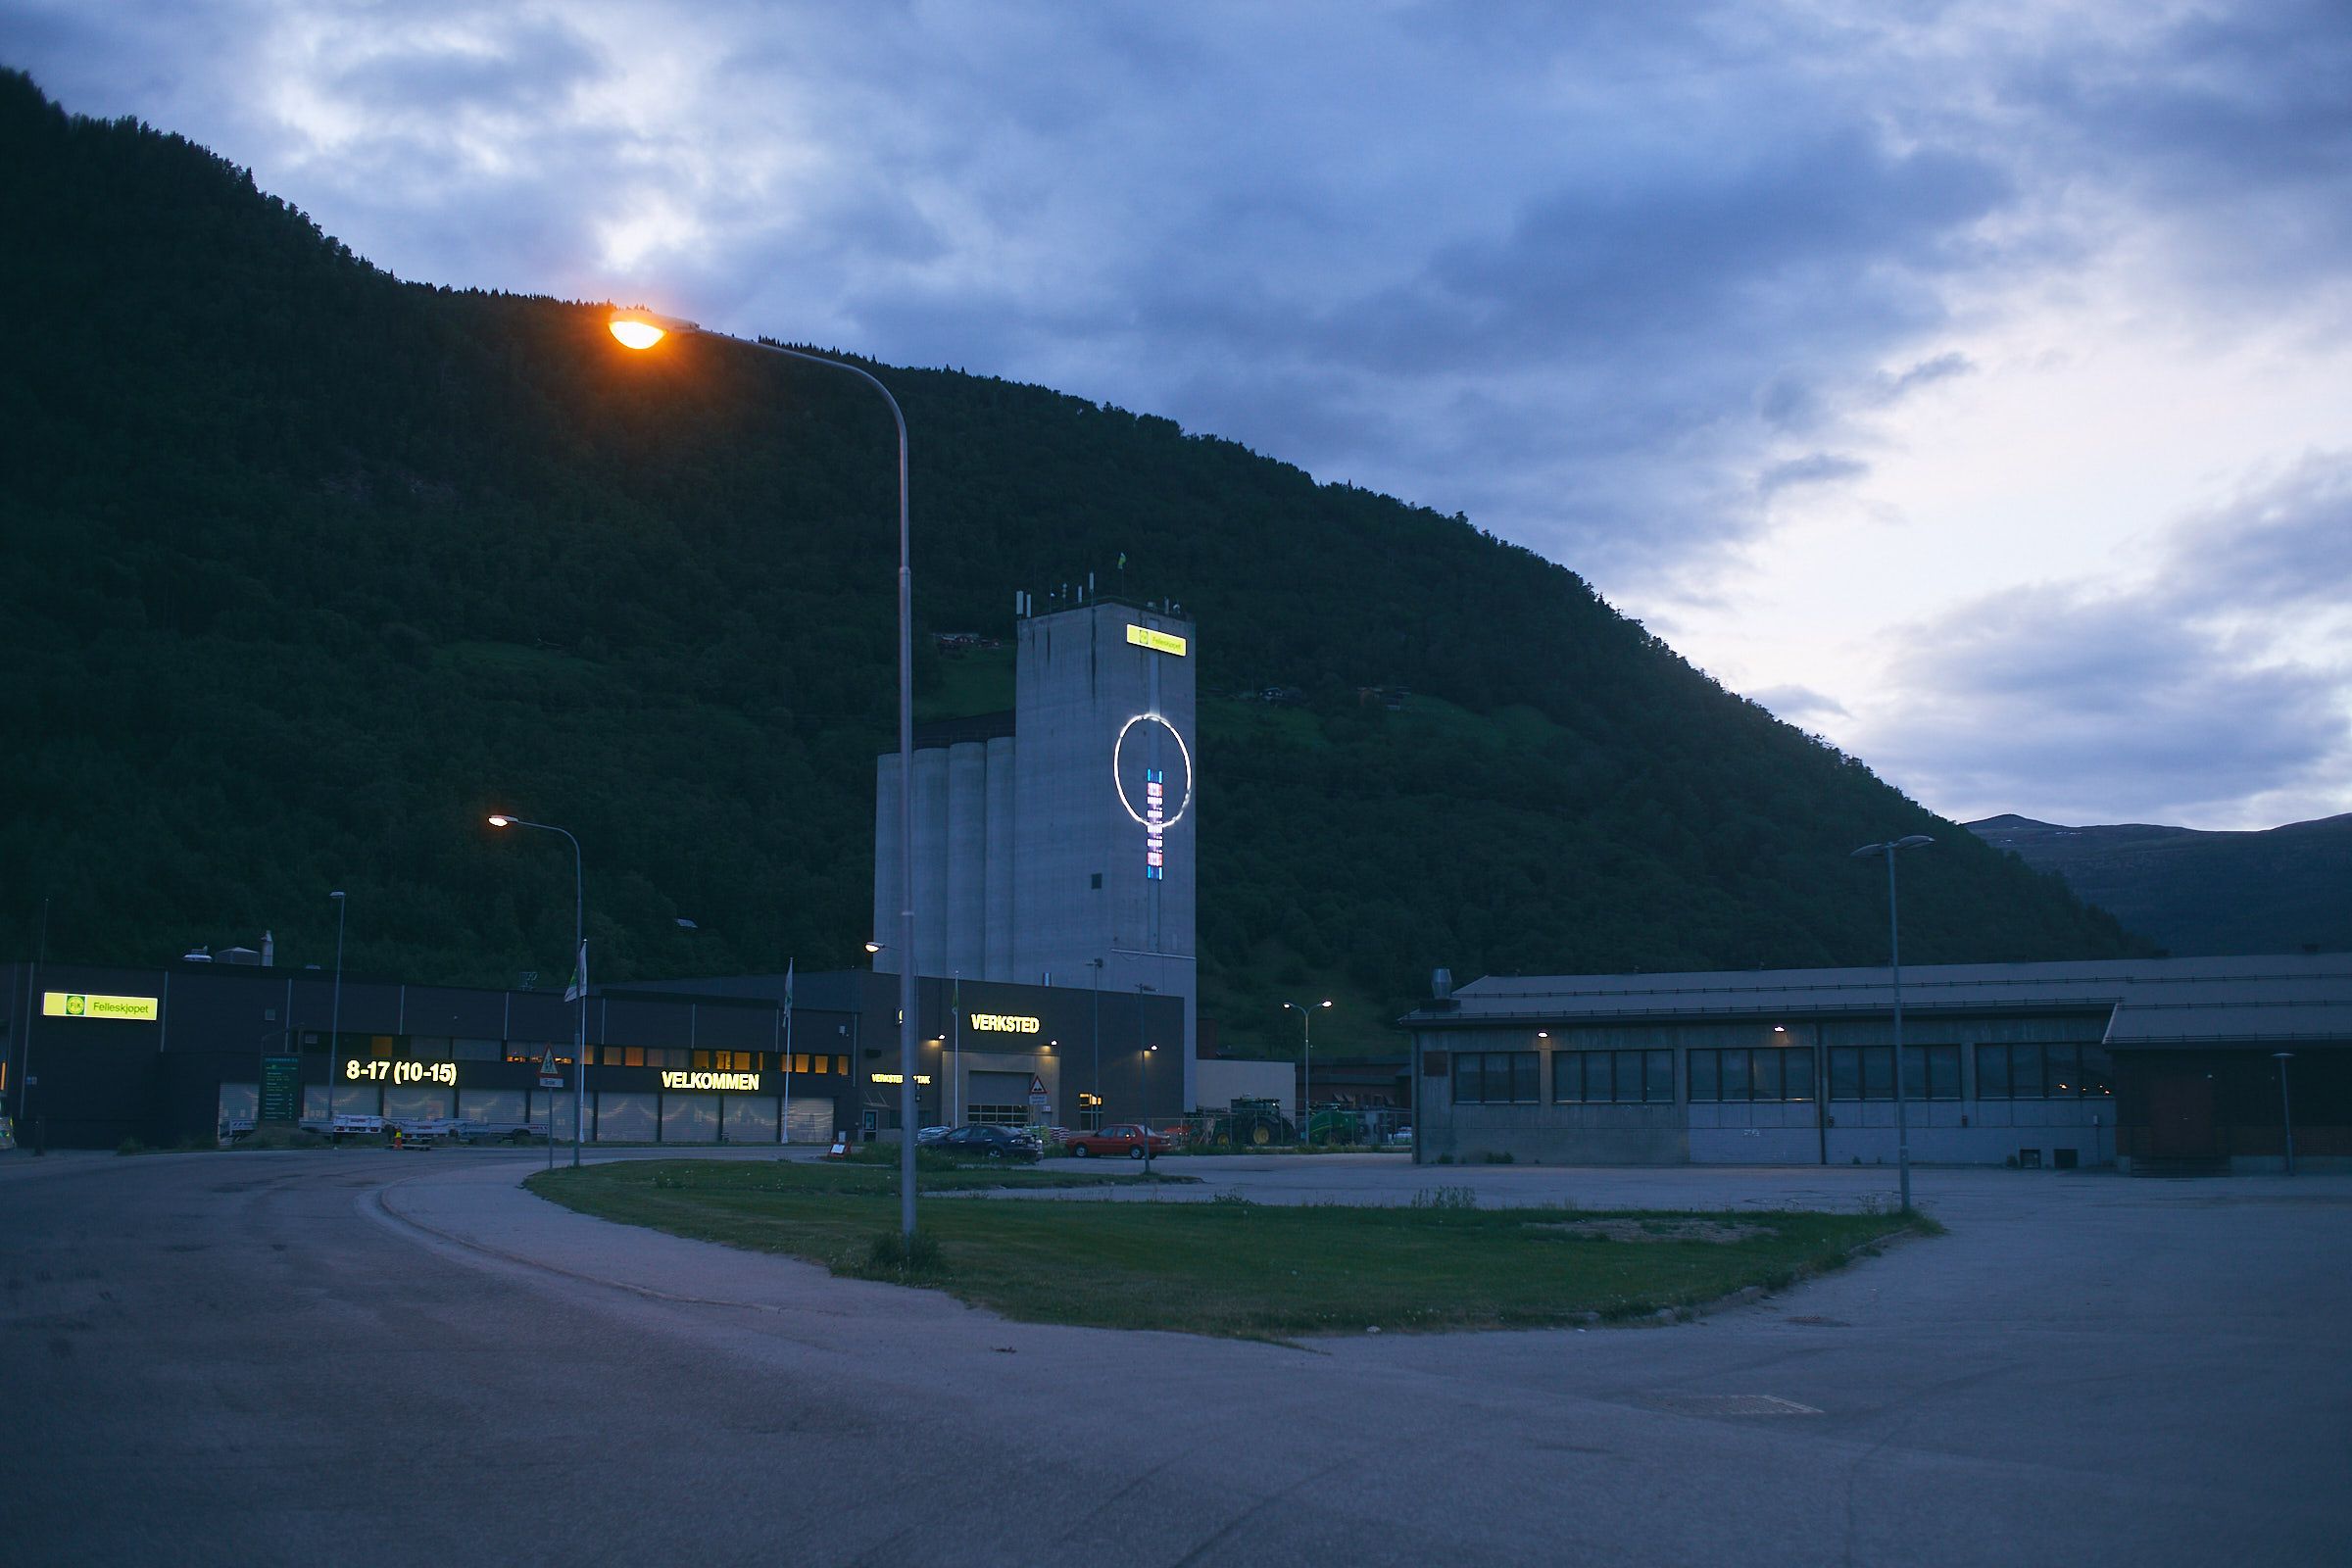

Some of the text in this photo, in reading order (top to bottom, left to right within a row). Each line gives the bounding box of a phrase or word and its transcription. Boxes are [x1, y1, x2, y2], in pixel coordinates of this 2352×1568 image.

[93, 1002, 149, 1014] Felleskjøpet
[970, 1013, 1040, 1033] VERKSTED
[346, 1059, 458, 1087] 8-17 (10-15)
[662, 1070, 760, 1091] VELKOMMEN
